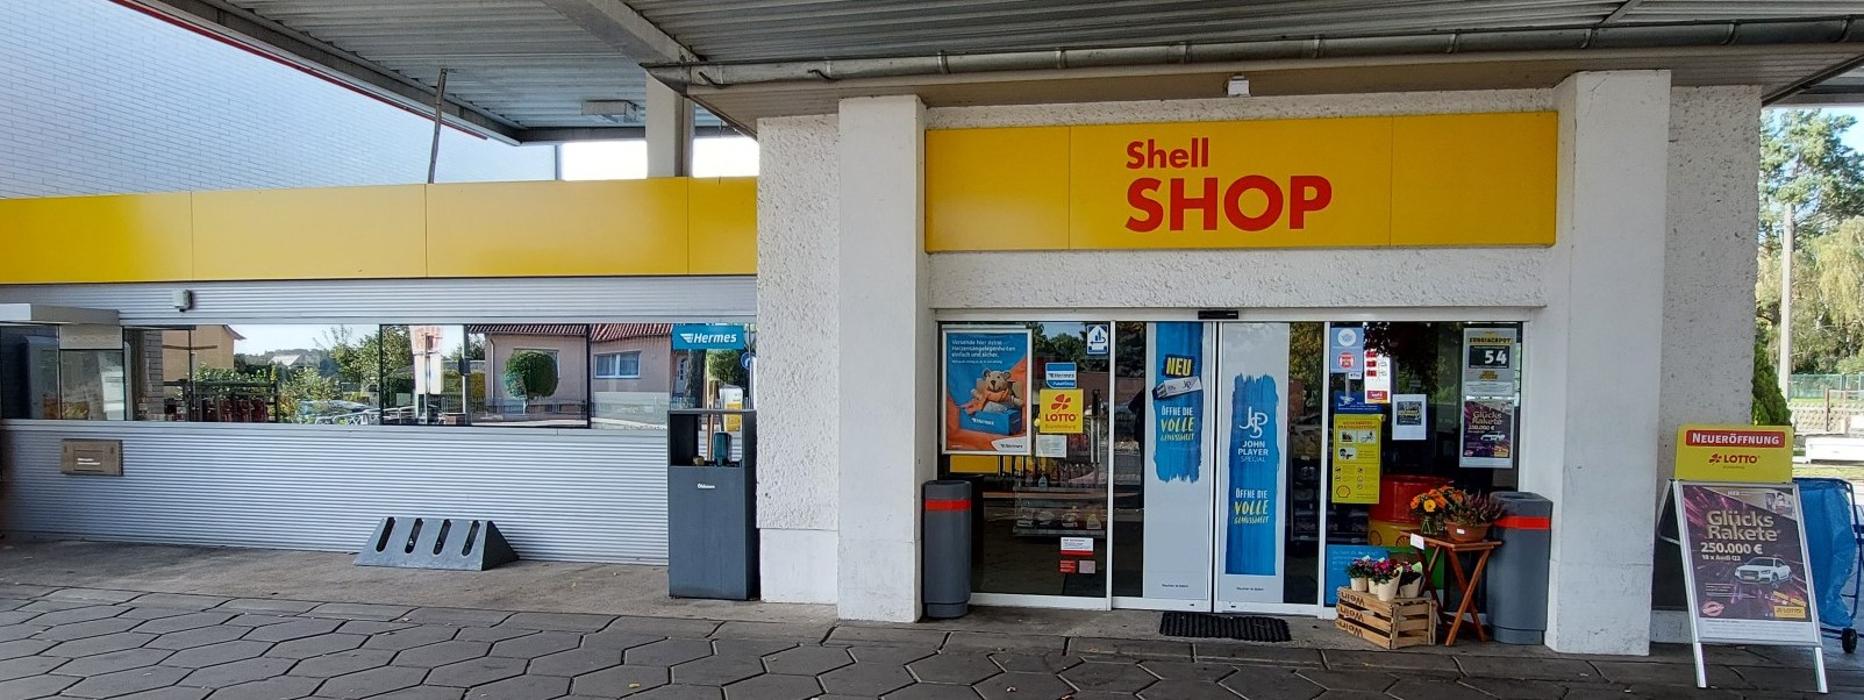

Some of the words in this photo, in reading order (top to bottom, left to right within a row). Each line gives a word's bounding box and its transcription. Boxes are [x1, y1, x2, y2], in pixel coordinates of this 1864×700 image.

[1126, 137, 1208, 169] Shell
[1125, 175, 1332, 232] SHOP
[694, 333, 737, 343] Hermes
[1485, 350, 1507, 364] 54
[1166, 357, 1192, 376] NEU
[1045, 413, 1077, 422] LOTTO
[1161, 406, 1181, 416] ÖFFNE
[1183, 406, 1193, 416] DIE
[1161, 417, 1195, 433] VOLLE
[1238, 448, 1269, 456] PLAYER
[1724, 455, 1758, 464] LOTTO
[1235, 488, 1255, 499] ÖFFNE
[1257, 490, 1268, 499] DIE
[1234, 500, 1269, 515] VOLLE
[1706, 510, 1774, 527] Glücks
[1707, 525, 1778, 541] Rakete
[1701, 542, 1751, 554] 250.000
[1753, 544, 1763, 554] €
